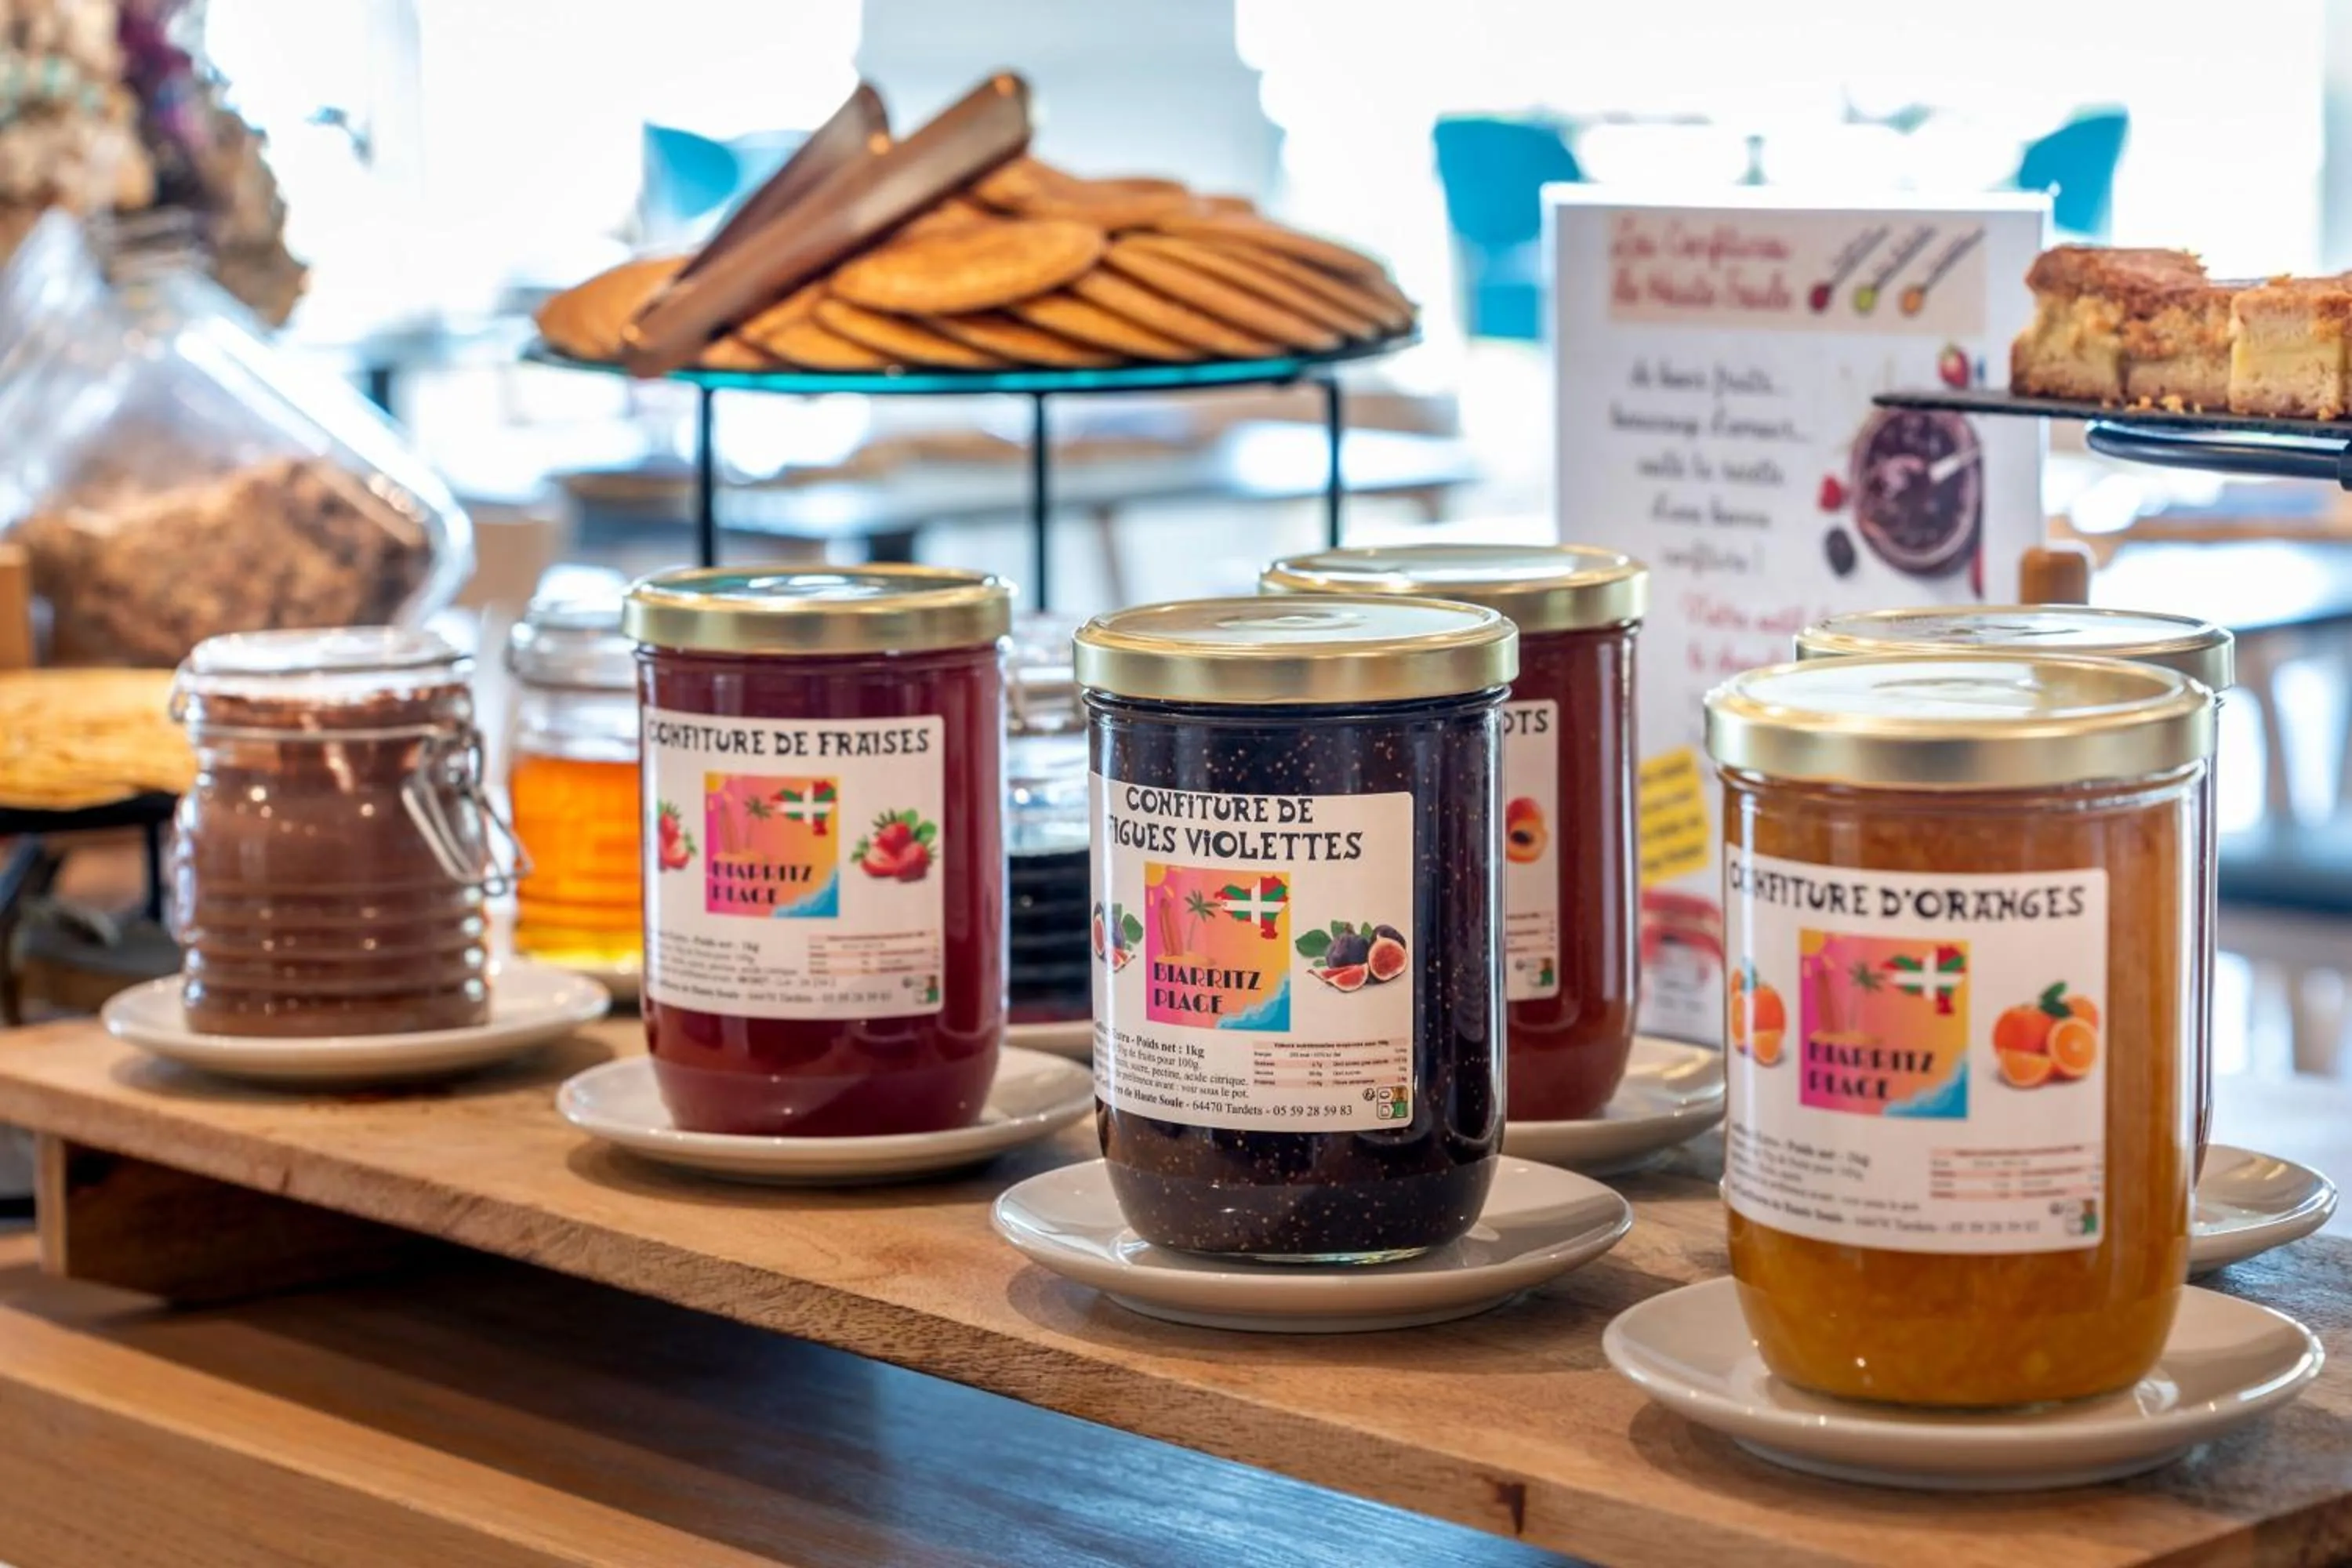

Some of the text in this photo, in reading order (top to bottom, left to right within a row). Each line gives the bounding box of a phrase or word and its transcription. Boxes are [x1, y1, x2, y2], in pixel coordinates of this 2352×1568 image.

[774, 731, 809, 757] DE
[817, 728, 930, 757] FRAISES
[1277, 797, 1314, 823] DE
[1879, 885, 2085, 920] D'ORANGES
[1153, 962, 1261, 990] BIARRITZ
[1154, 988, 1224, 1014] PLAGE
[1136, 1035, 1160, 1050] Poids
[1161, 1043, 1176, 1053] net
[1186, 1044, 1205, 1058] 1kg
[1192, 1100, 1223, 1112] 64470
[1272, 1105, 1287, 1116] 05
[1290, 1106, 1303, 1116] 59
[1307, 1106, 1320, 1116] 28
[1323, 1105, 1337, 1116] 59
[1340, 1105, 1352, 1116] 83
